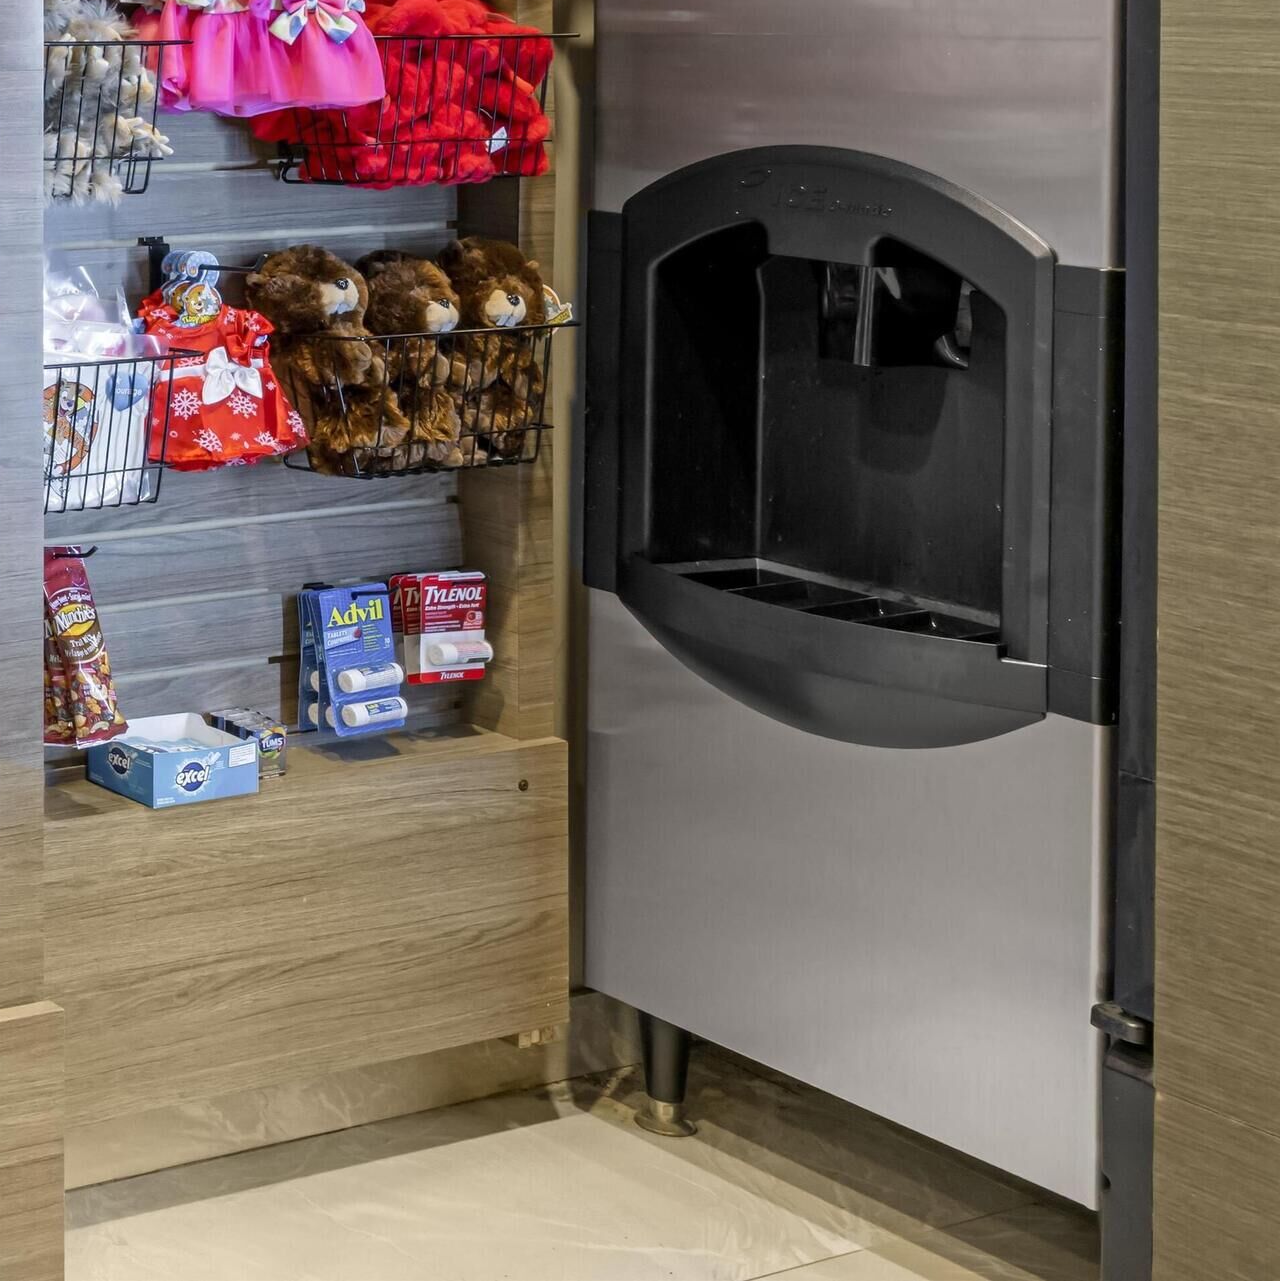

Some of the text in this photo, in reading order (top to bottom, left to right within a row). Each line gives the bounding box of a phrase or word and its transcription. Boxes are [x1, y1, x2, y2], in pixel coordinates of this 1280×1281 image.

[425, 586, 482, 604] TYLENOL
[327, 599, 383, 628] Advil
[262, 738, 283, 749] TUMS
[108, 752, 132, 770] excel
[176, 765, 210, 786] excel
